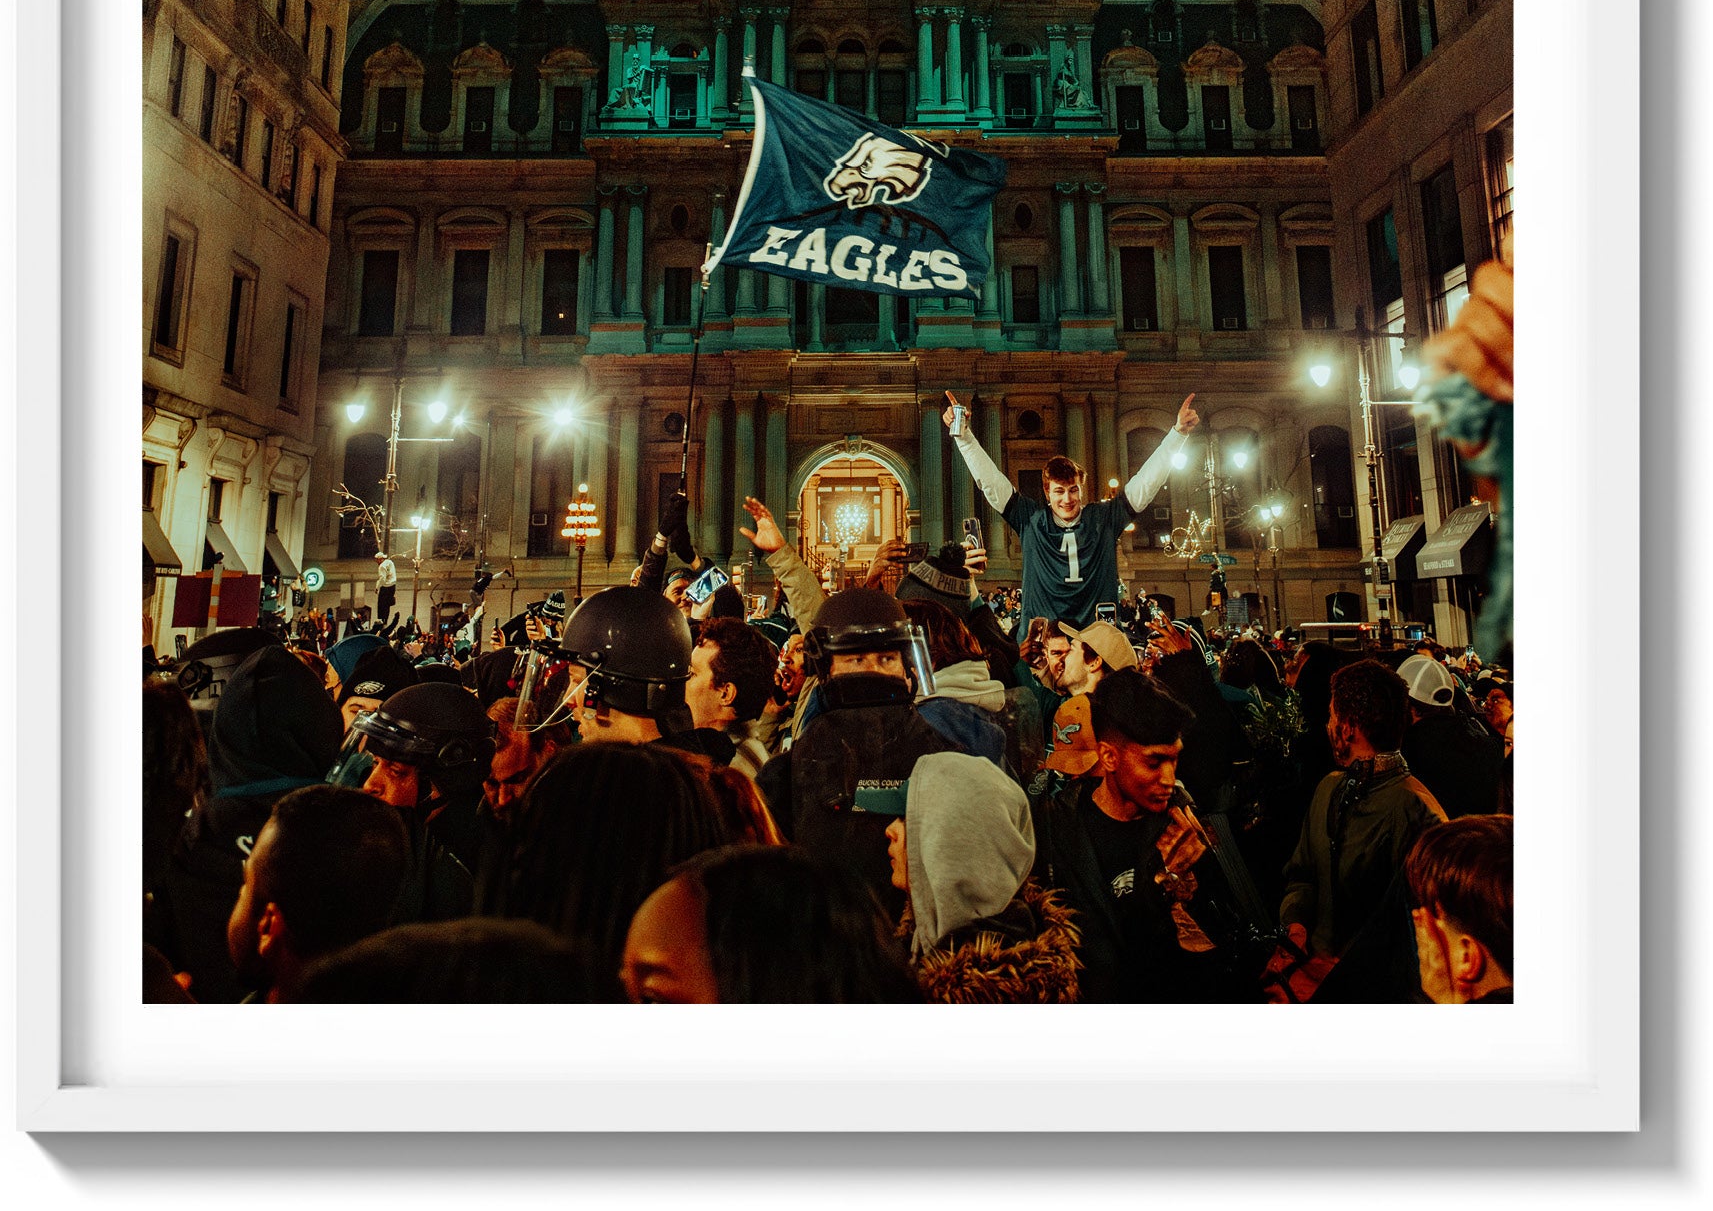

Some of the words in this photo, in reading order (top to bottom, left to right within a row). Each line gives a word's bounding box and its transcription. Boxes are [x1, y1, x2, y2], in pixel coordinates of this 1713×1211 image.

[748, 225, 969, 291] EAGLES
[1060, 532, 1084, 583] 1
[858, 779, 880, 787] BUCKS
[881, 779, 907, 787] COUNT
